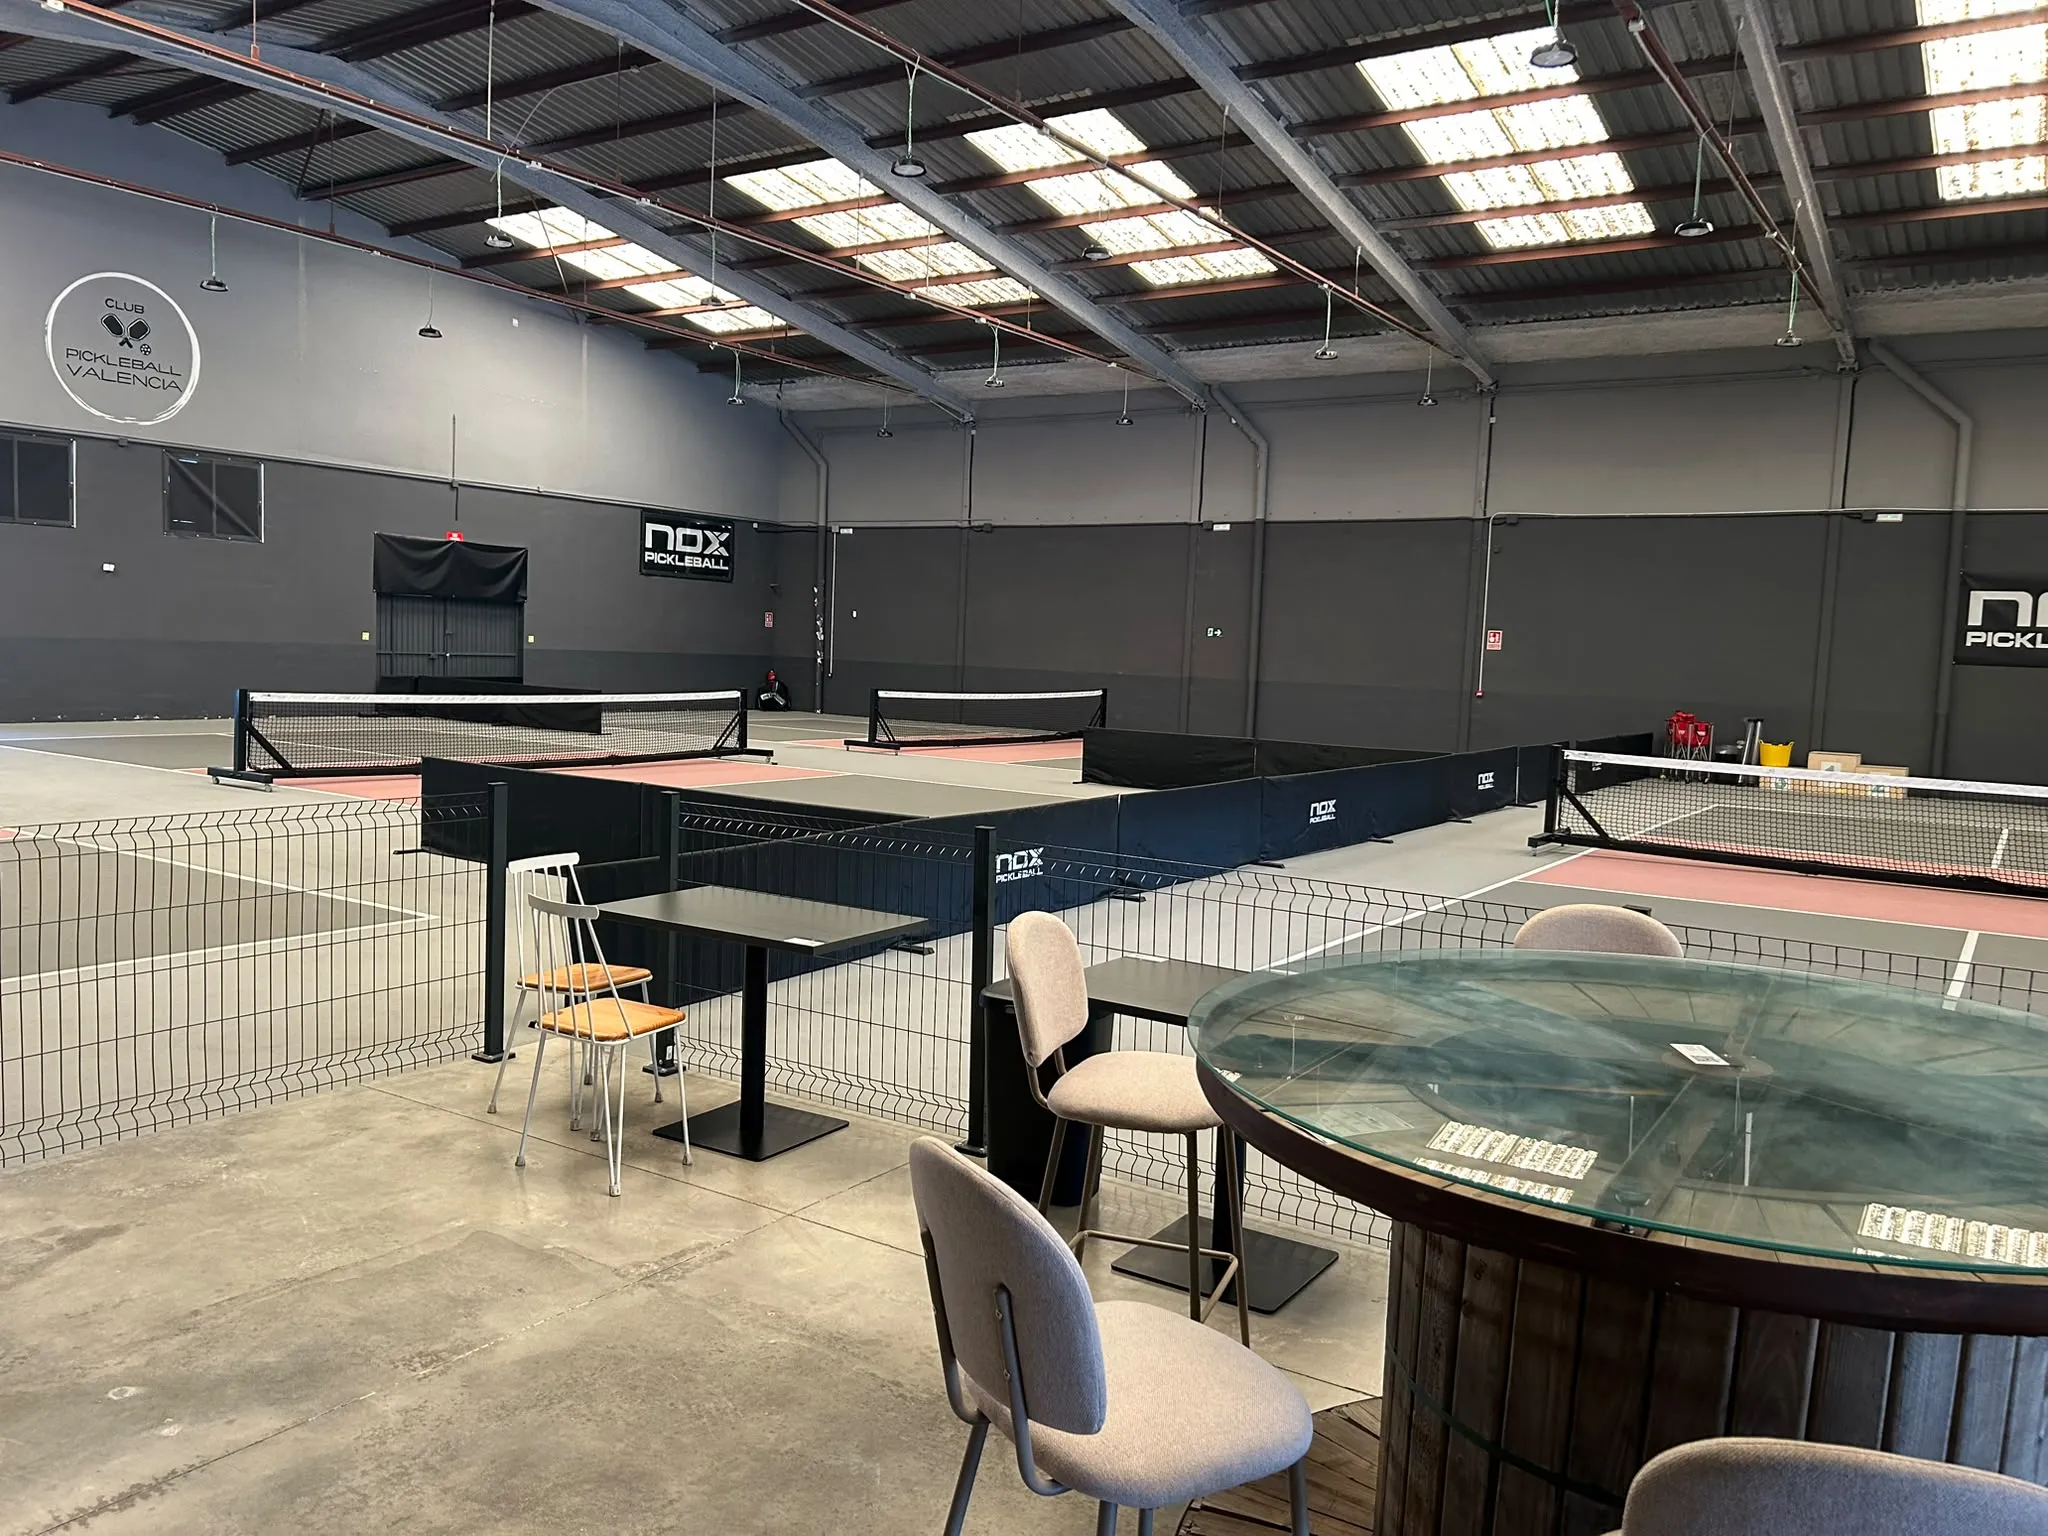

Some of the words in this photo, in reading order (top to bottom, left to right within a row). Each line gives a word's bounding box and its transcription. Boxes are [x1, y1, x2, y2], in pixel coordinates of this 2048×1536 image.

[105, 298, 145, 314] CLUB
[66, 348, 182, 377] PICKLEBALL
[66, 363, 183, 393] VALENCIA
[644, 551, 729, 570] PICKLEBALL
[1965, 631, 2048, 649] PICKL
[995, 866, 1044, 884] PICKLEBALL
